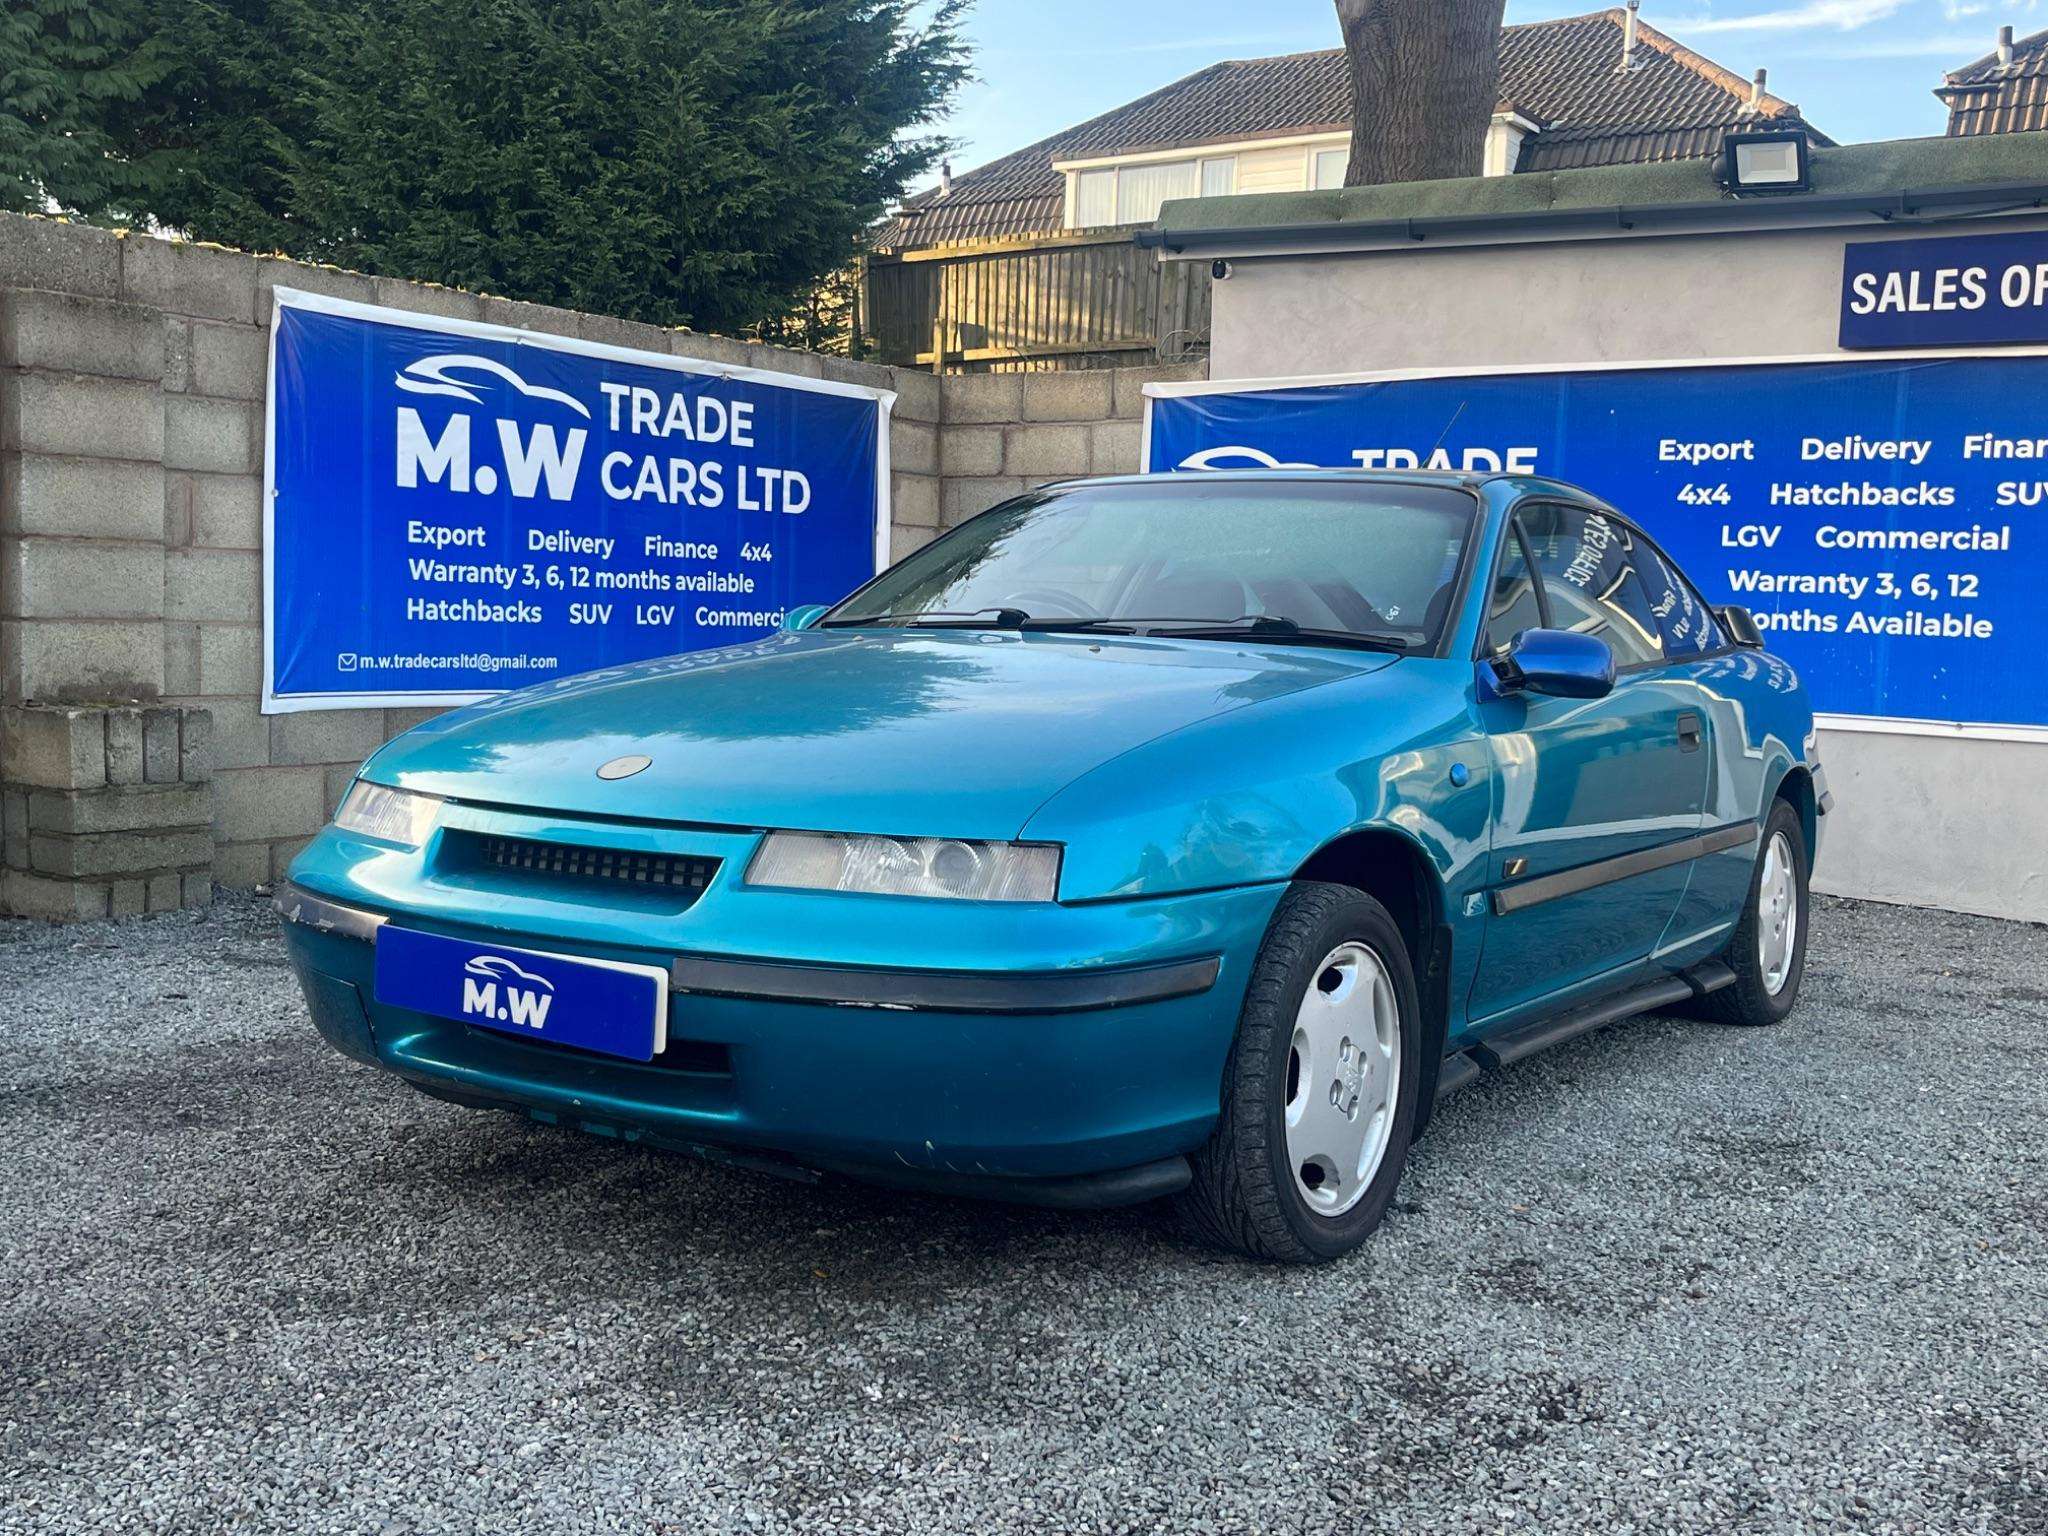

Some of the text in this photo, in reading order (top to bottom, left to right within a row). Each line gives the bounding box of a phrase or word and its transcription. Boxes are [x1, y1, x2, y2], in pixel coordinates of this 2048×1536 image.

[1851, 267, 1986, 314] SALES
[601, 382, 755, 448] TRADE
[397, 407, 588, 500] M.W
[1659, 440, 1754, 465] Export
[1802, 435, 1931, 464] Delivery
[602, 452, 810, 513] CARS LTD
[1677, 482, 2048, 505] 4x4 Hatchbacks SU
[409, 521, 771, 561] Export Delivery Finance 4x4
[1722, 525, 2009, 550] LGV Commercial
[409, 559, 754, 592] Warranty 3, 6, 12 months available
[1728, 570, 1978, 600] Warranty 3, 6, 12
[408, 598, 541, 622] Hatchbacks
[570, 604, 612, 624] SUV
[637, 606, 674, 624] LGV
[1746, 609, 1992, 638] onths Available
[361, 654, 557, 671] m.w.tradecarsltd@gmail.com
[463, 978, 553, 1029] M.W
